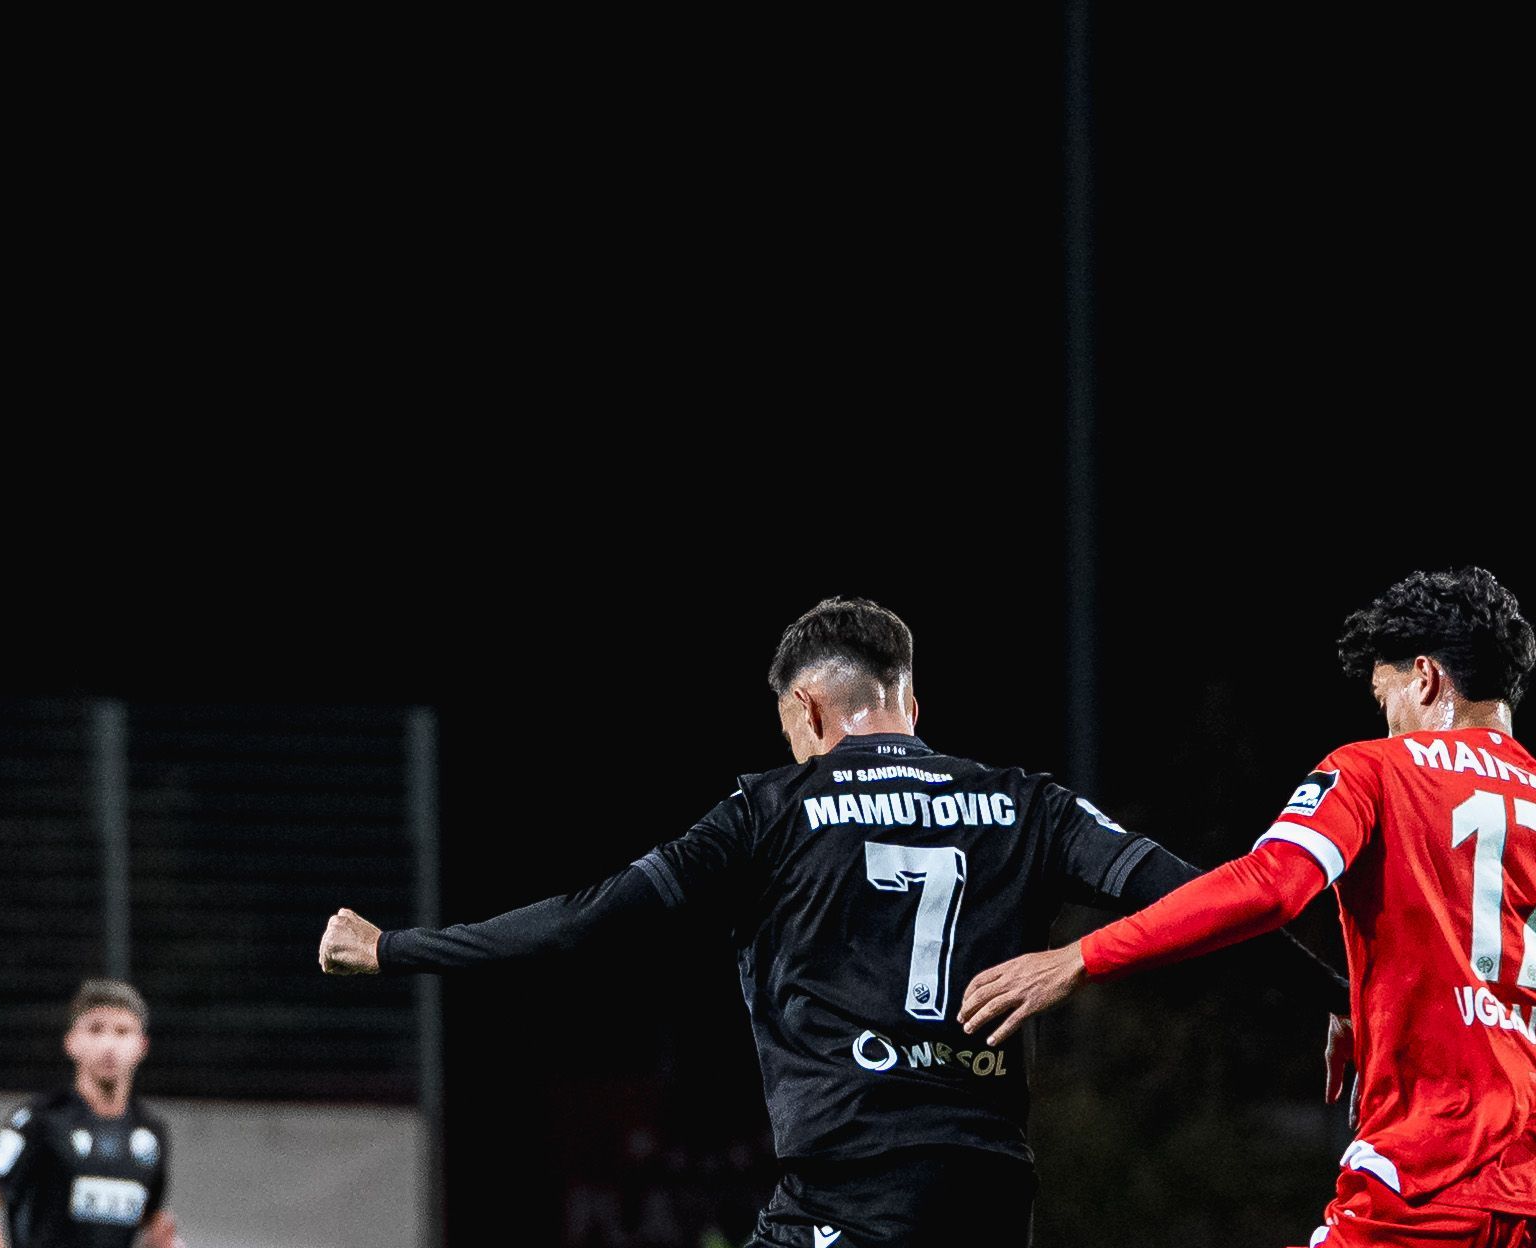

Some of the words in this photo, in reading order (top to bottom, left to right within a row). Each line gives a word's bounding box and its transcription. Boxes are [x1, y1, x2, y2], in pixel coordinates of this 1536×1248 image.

[832, 768, 853, 783] SV
[856, 765, 954, 783] SANDHAUSEN
[804, 792, 1016, 830] MAMUTOVIC
[865, 841, 966, 1020] 7
